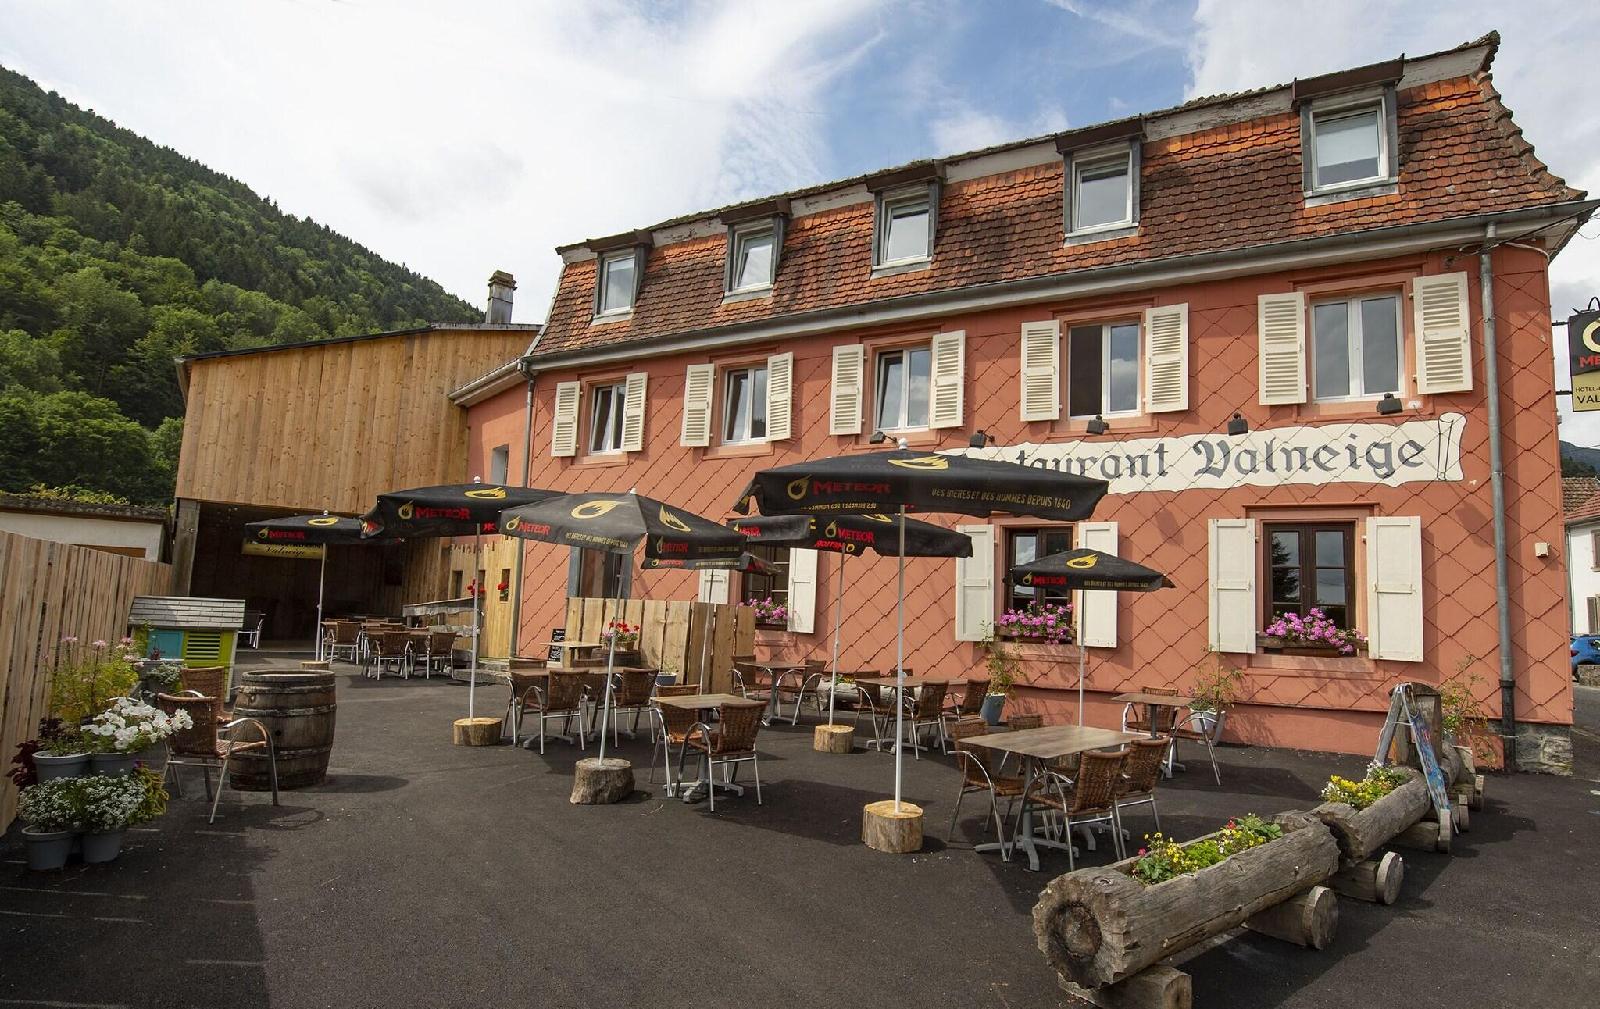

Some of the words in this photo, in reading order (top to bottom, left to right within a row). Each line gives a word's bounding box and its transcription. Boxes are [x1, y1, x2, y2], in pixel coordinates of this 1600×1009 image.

[1016, 442, 1169, 480] taurant
[1193, 434, 1425, 480] Valneige
[813, 481, 891, 495] METEOR
[1027, 495, 1052, 507] DEPUIS
[1054, 497, 1071, 510] 1640
[415, 506, 470, 520] METEOR
[518, 521, 551, 535] METEOR
[837, 528, 874, 544] METEOR
